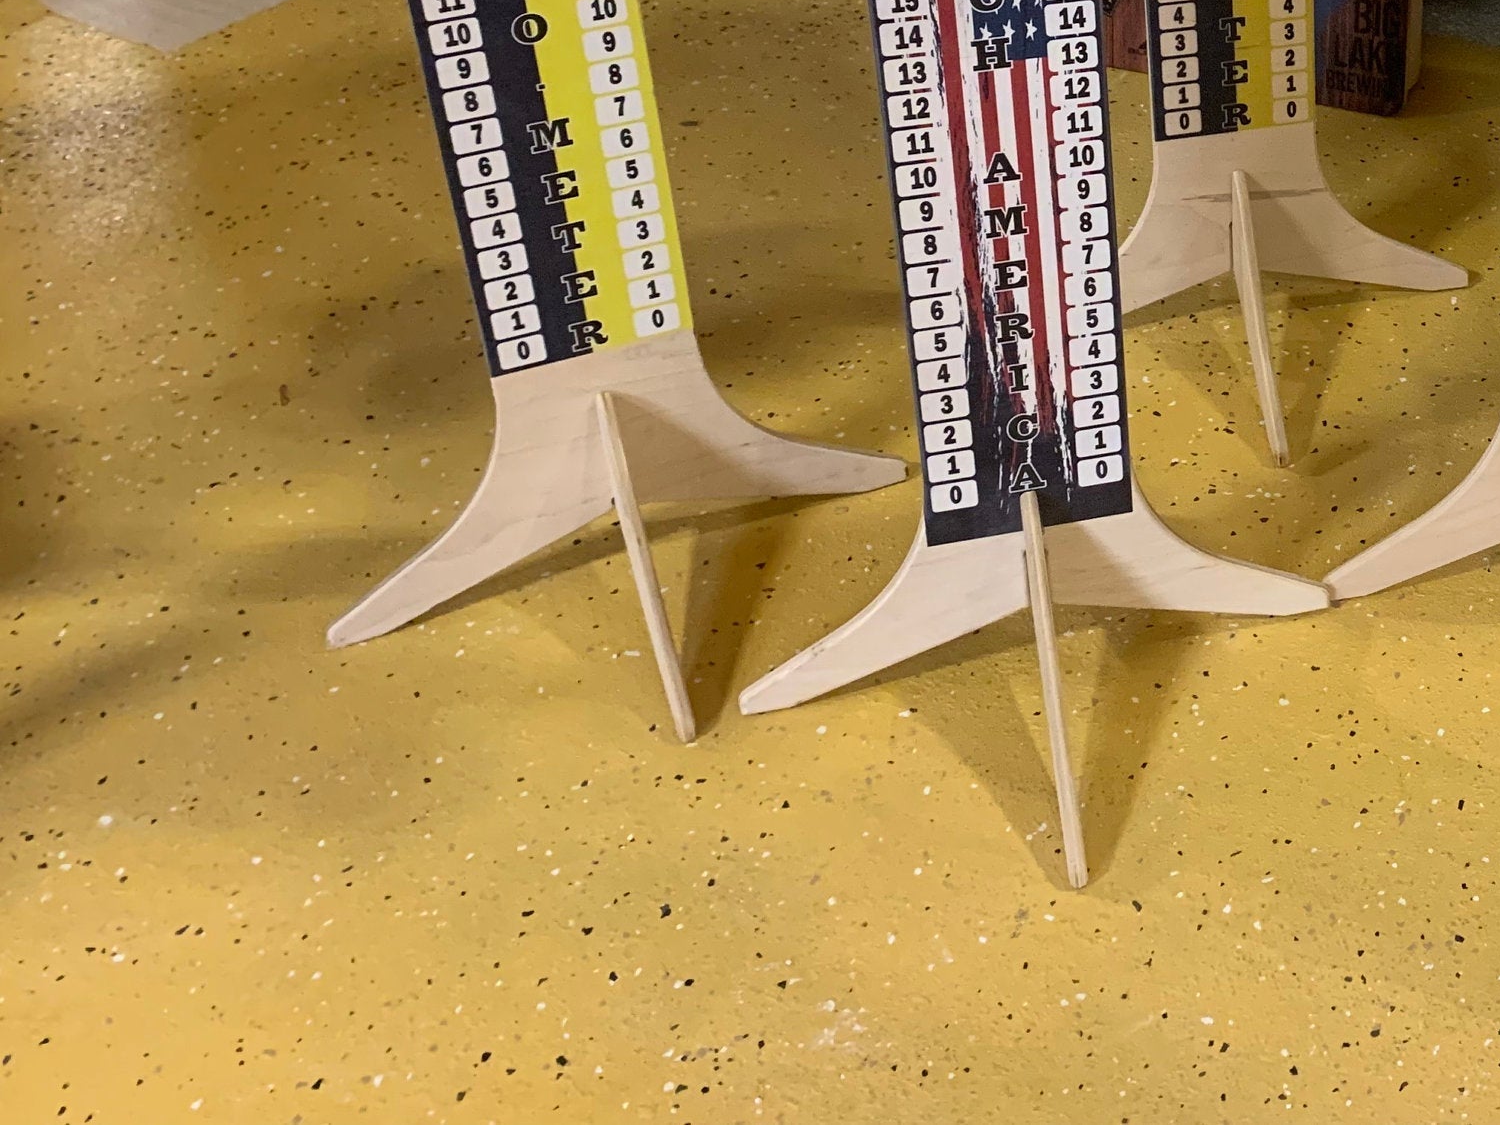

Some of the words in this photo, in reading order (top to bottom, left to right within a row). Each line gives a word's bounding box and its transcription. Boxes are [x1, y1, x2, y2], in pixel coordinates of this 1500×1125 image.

[1058, 5, 1087, 31] 14
[443, 22, 471, 48] 10
[894, 24, 924, 50] 14
[1286, 100, 1297, 118] 0
[1066, 110, 1094, 135] 11
[1179, 112, 1190, 131] 0
[906, 131, 935, 156] 11
[625, 159, 639, 180] 5
[484, 187, 499, 209] 5
[1083, 276, 1097, 297] 6
[651, 309, 665, 328] 0
[930, 300, 945, 321] 6
[516, 340, 531, 360] 0
[1095, 459, 1108, 479] 0
[949, 485, 963, 505] 0
